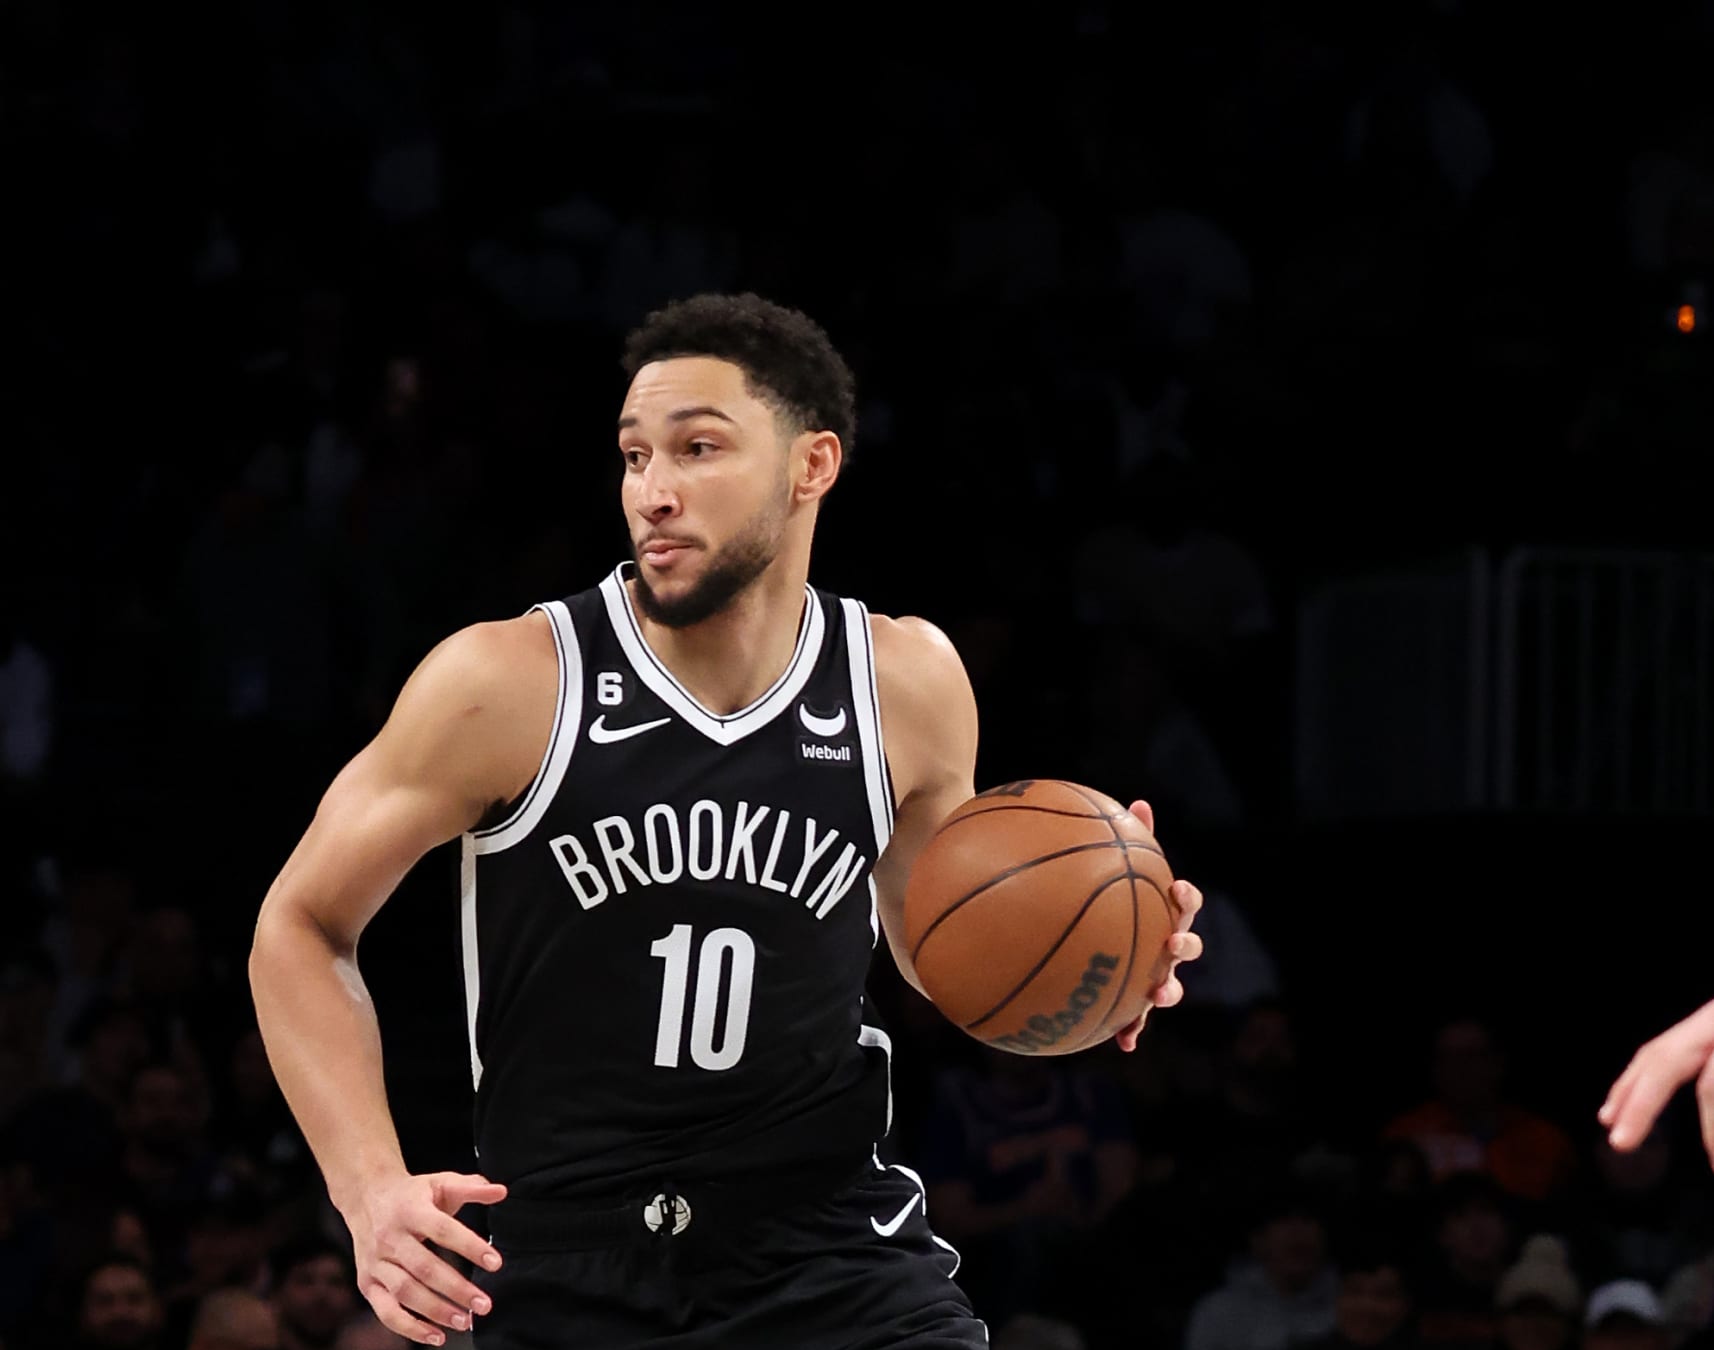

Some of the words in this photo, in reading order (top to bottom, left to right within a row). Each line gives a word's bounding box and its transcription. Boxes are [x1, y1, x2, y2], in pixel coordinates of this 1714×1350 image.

[598, 672, 622, 705] 6
[801, 743, 851, 761] Webull
[548, 799, 866, 919] BROOKLYN
[651, 924, 756, 1070] 10
